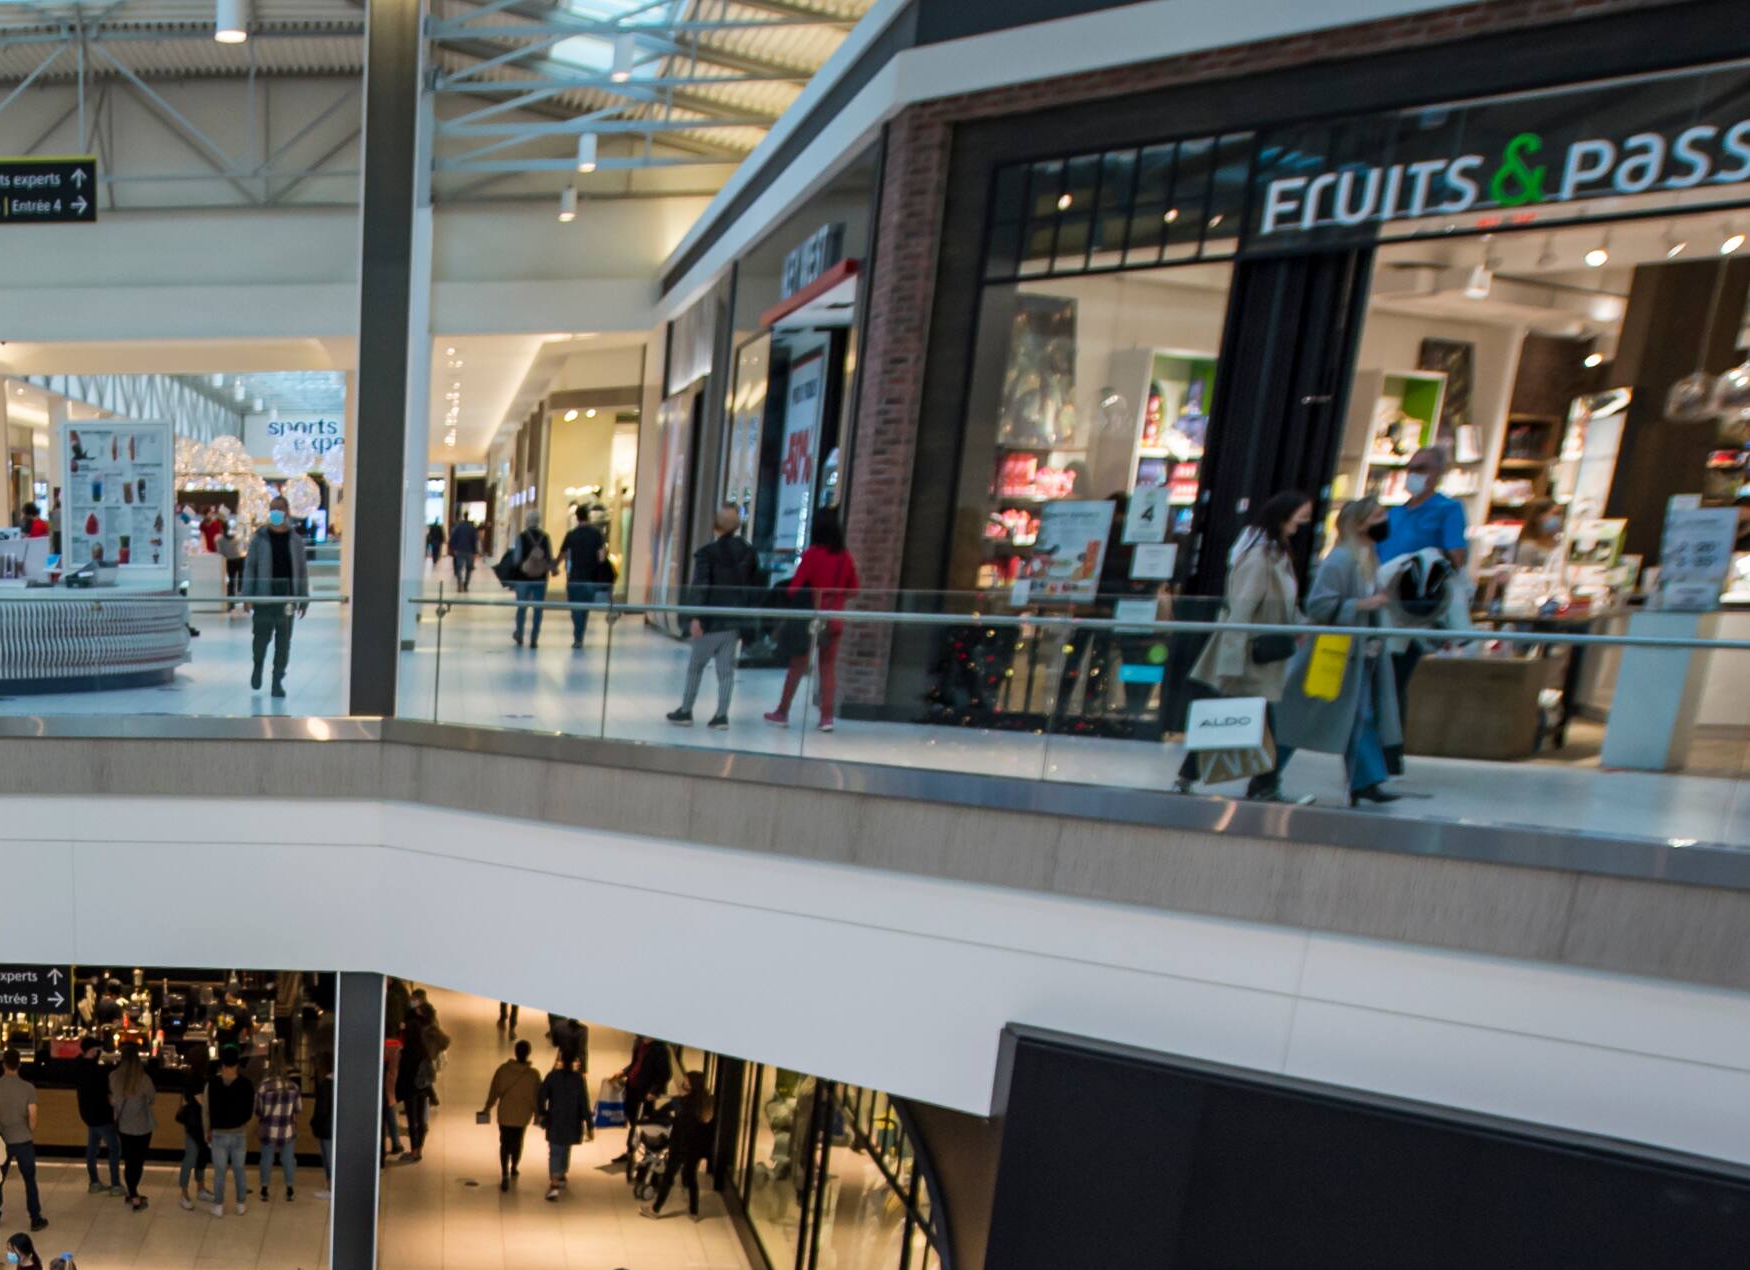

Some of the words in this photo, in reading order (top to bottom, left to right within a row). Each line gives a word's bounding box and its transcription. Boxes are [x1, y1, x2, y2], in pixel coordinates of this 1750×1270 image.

[1489, 132, 1546, 208] &
[13, 173, 61, 189] experts
[11, 199, 50, 213] Entrée
[53, 199, 62, 213] 4
[1140, 503, 1155, 522] 4
[1199, 714, 1252, 729] ALDO
[30, 993, 39, 1006] 3
